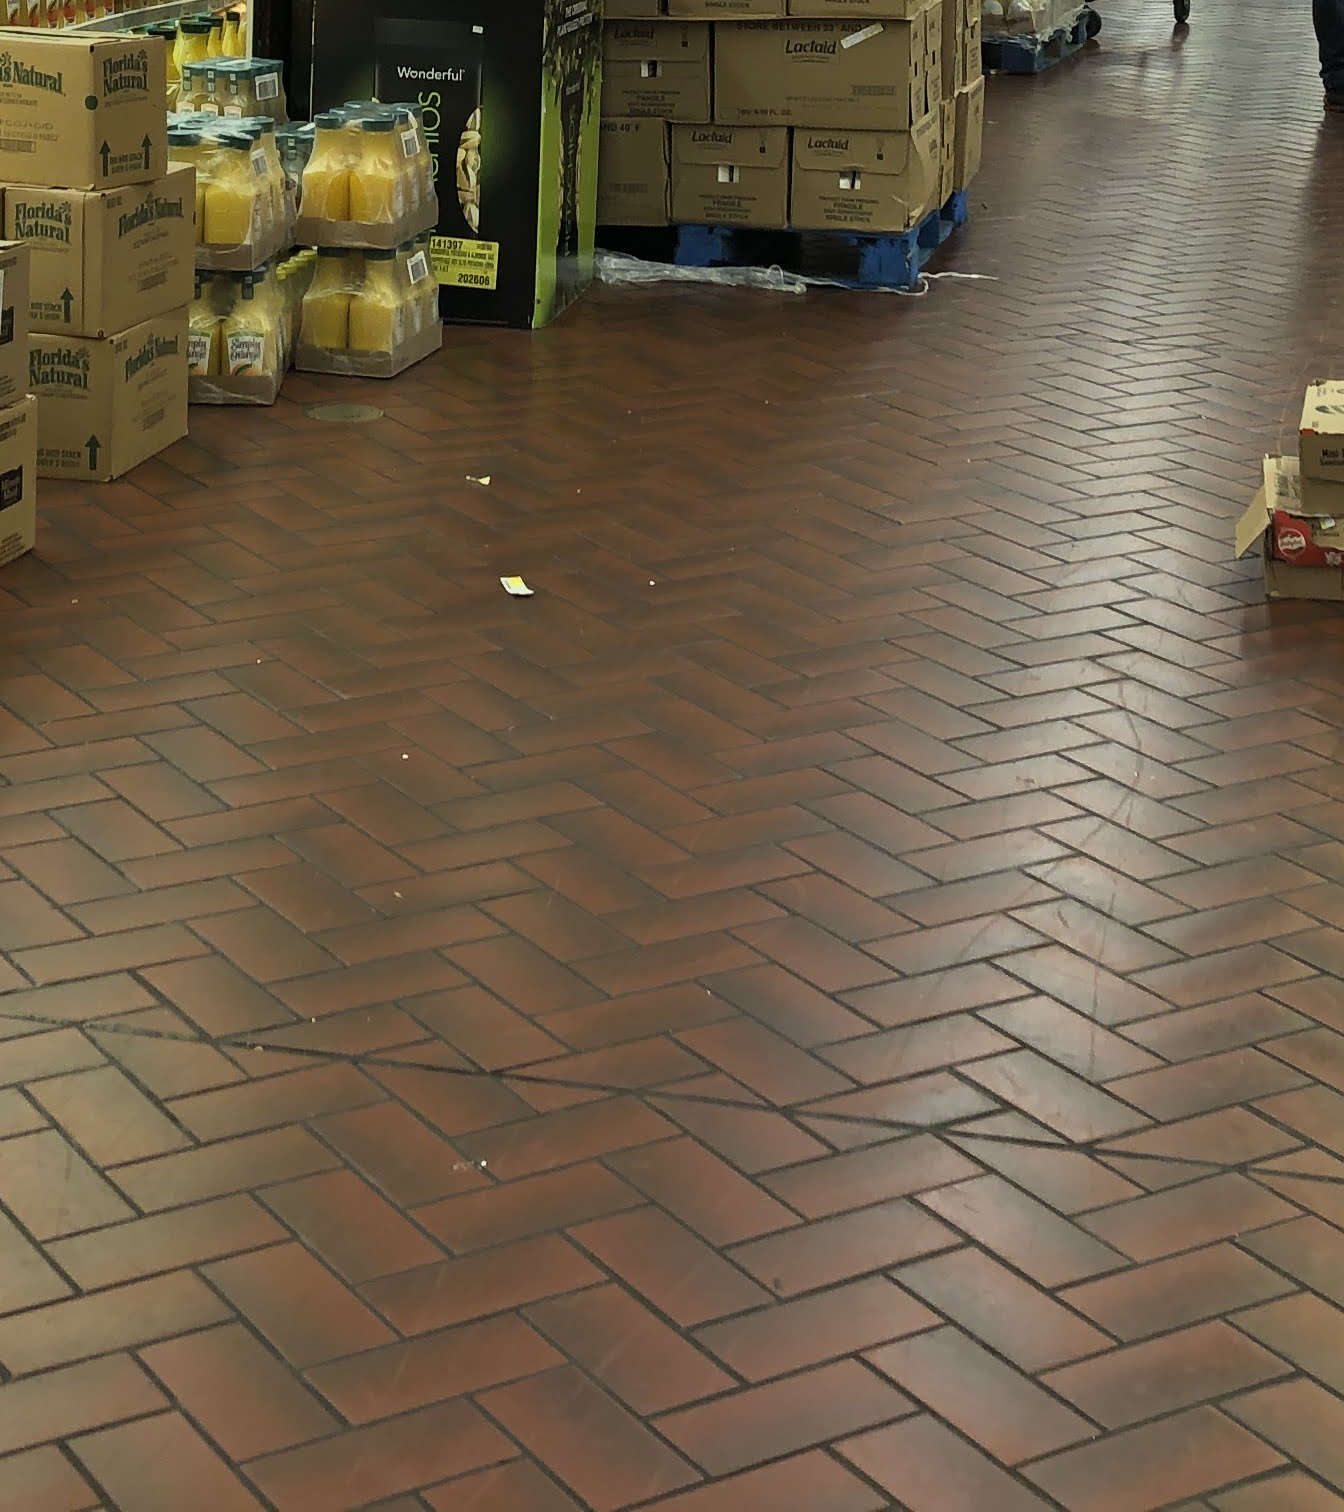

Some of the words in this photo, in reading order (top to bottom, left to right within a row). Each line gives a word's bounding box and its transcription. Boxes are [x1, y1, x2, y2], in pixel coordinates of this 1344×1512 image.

[785, 40, 838, 56] Lactaid
[103, 55, 148, 77] Florida's
[397, 65, 462, 82] Wonderful
[103, 72, 149, 94] Natural
[692, 131, 732, 145] Lactaid
[808, 137, 849, 152] Lactaid
[15, 201, 72, 225] Florida's
[15, 220, 71, 245] Natural
[29, 347, 90, 372] Florida's
[29, 365, 89, 389] Natural
[1322, 448, 1340, 459] Mini
